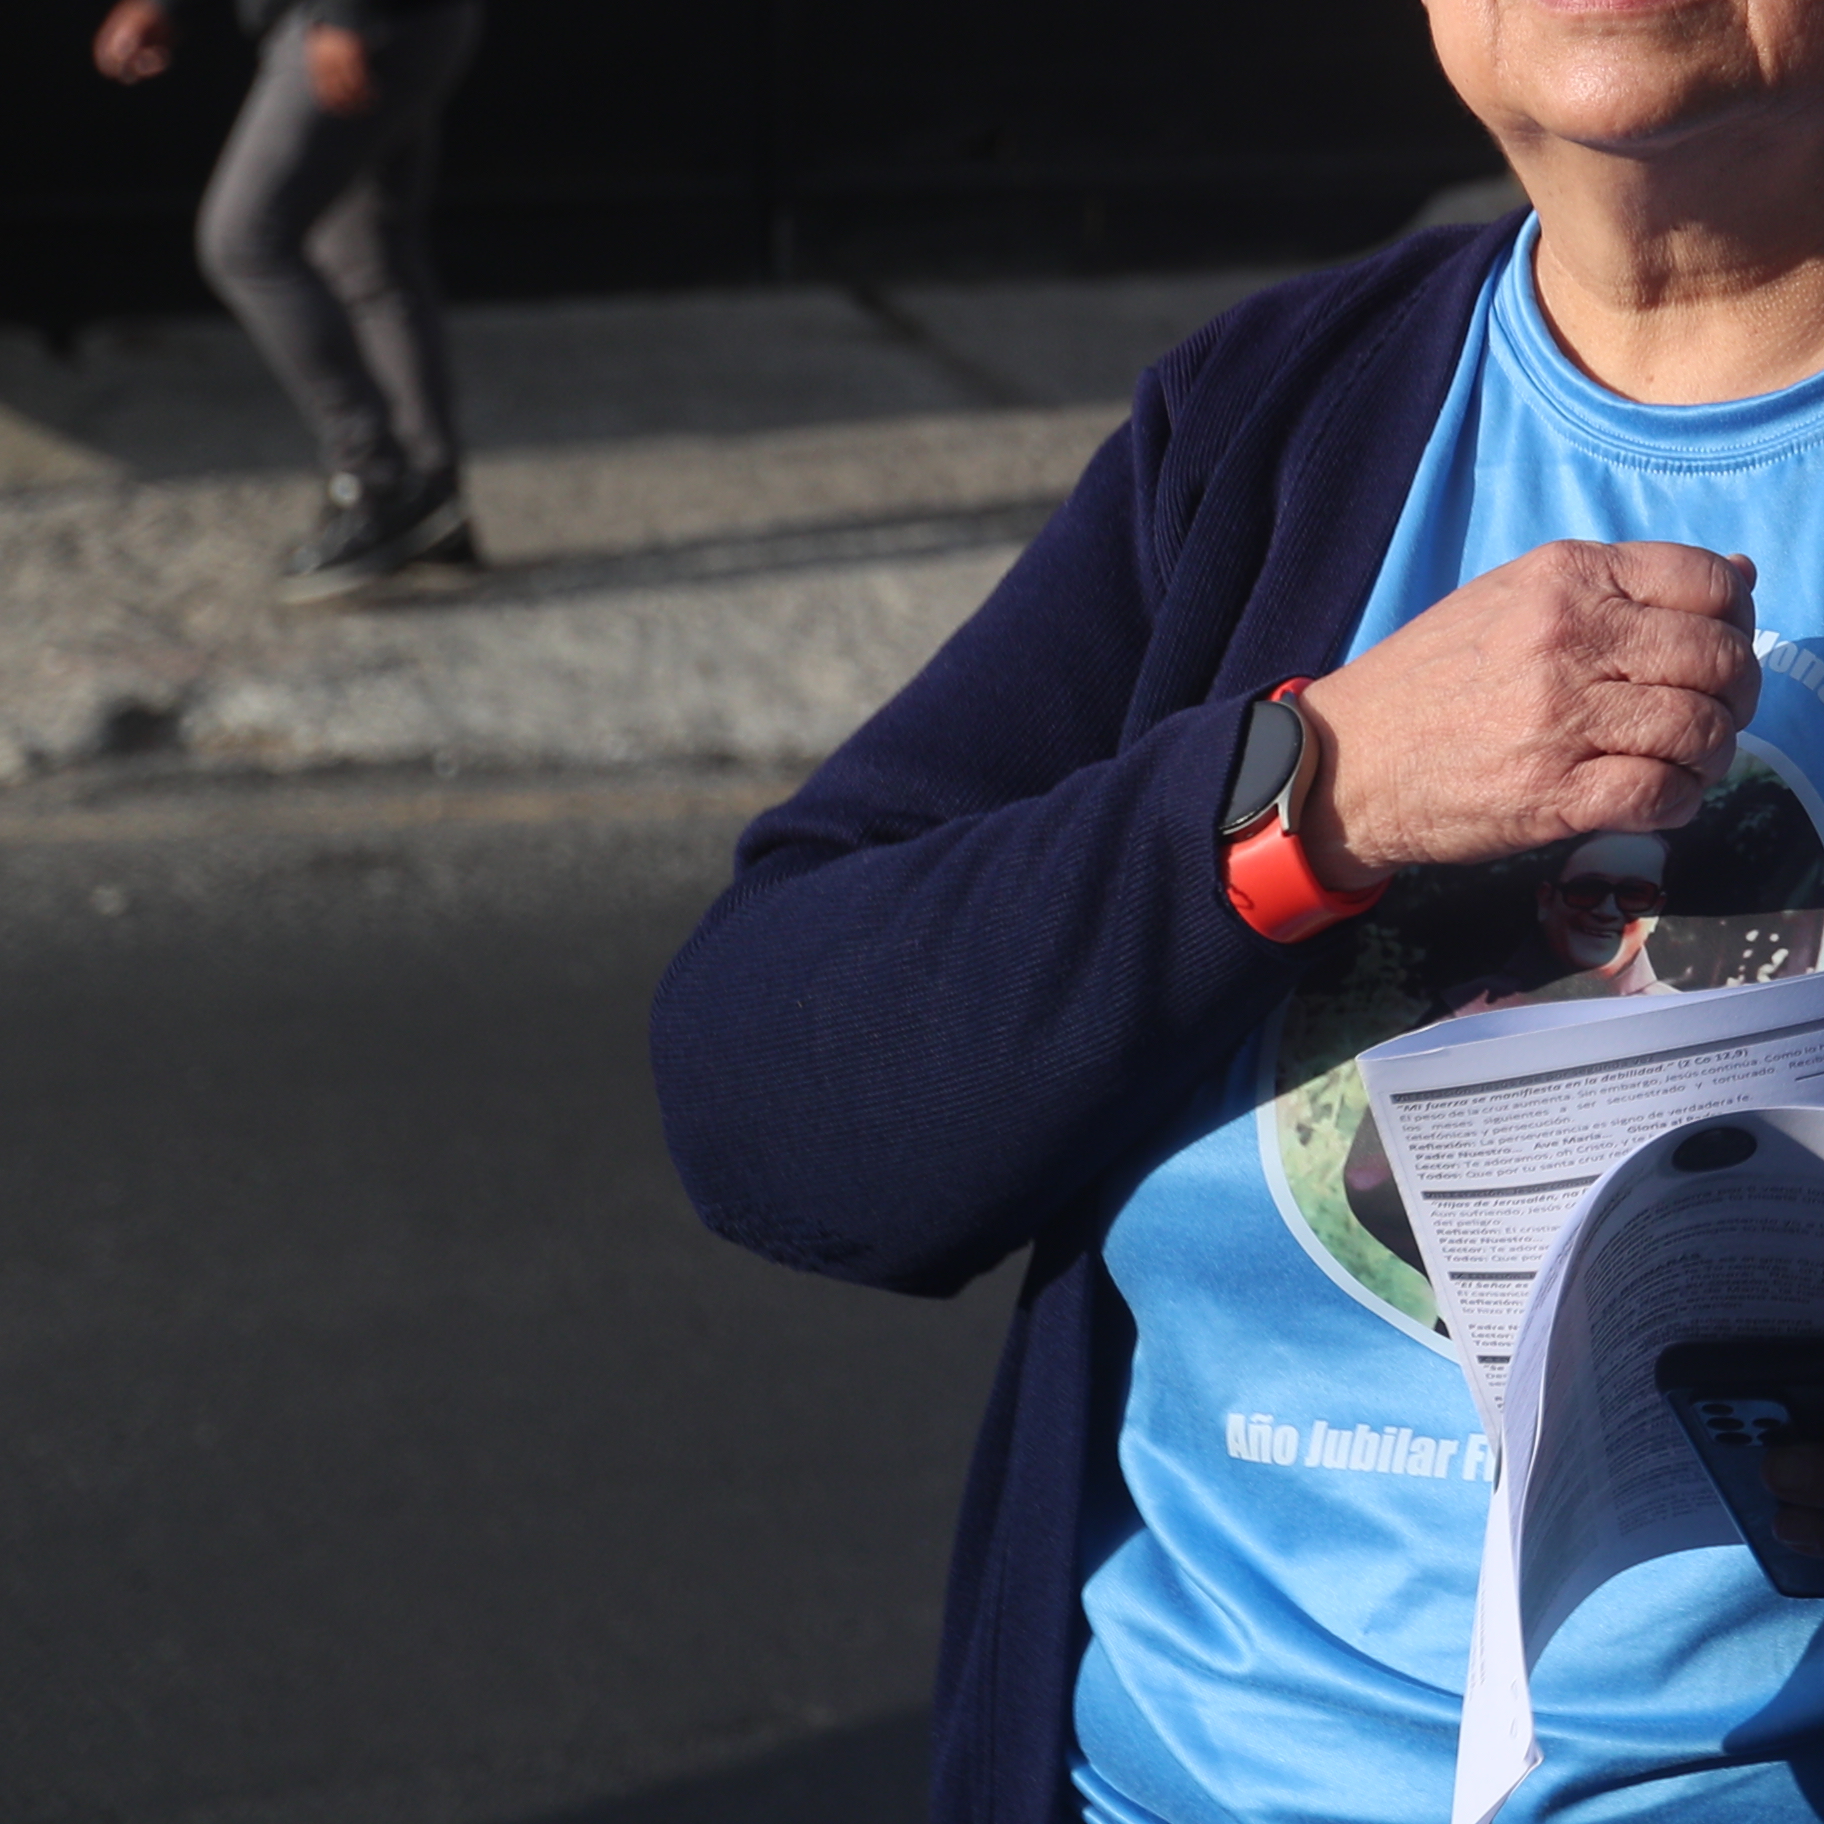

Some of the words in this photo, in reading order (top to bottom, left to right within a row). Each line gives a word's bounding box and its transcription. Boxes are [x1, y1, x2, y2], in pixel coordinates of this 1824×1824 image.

[1399, 1114, 1411, 1122] El
[1414, 1112, 1445, 1123] peso
[1448, 1109, 1465, 1117] de
[1467, 1108, 1480, 1116] la
[1482, 1105, 1509, 1114] cruz
[1577, 1088, 1597, 1098] Sin
[1599, 1077, 1662, 1094] embargo,
[1664, 1071, 1699, 1085] Jesús
[1764, 1049, 1801, 1064] Como
[1804, 1046, 1817, 1055] lo
[1425, 1098, 1468, 1111] fuerza
[1489, 1083, 1561, 1102] manifiesta
[1565, 1080, 1581, 1089] en
[1585, 1076, 1597, 1086] la
[1677, 1059, 1690, 1070] (2
[1694, 1056, 1711, 1066] Co
[1715, 1047, 1748, 1063] 12,9)
[1546, 1072, 1571, 1084] por
[1574, 1062, 1628, 1077] segunda
[1402, 1124, 1421, 1133] los
[1431, 1121, 1473, 1131] meses
[1483, 1109, 1550, 1125] siguientes
[1577, 1101, 1597, 1110] ser
[1606, 1085, 1686, 1106] secuestrado
[1695, 1081, 1703, 1090] y
[1405, 1130, 1477, 1141] telefónicas
[1482, 1129, 1490, 1138] y
[1492, 1117, 1575, 1136] persecución.
[1409, 1140, 1476, 1151] Reflexión:
[1479, 1138, 1494, 1146] La
[1498, 1125, 1589, 1145] perseverancia
[1610, 1115, 1645, 1127] signo
[1648, 1111, 1664, 1120] de
[1669, 1098, 1733, 1116] verdadera
[1415, 1152, 1454, 1161] Padre
[1533, 1139, 1560, 1150] Ave
[1627, 1121, 1668, 1133] Gloria
[1671, 1117, 1683, 1126] al
[1415, 1162, 1459, 1171] Lector:
[1465, 1160, 1478, 1168] Te
[1484, 1153, 1553, 1167] adoramos,
[1556, 1149, 1573, 1158] oh
[1576, 1141, 1618, 1154] Cristo,
[1622, 1138, 1630, 1147] y
[1632, 1135, 1645, 1144] te
[1417, 1171, 1461, 1180] Todos:
[1465, 1169, 1493, 1179] Que
[1497, 1166, 1519, 1177] por
[1522, 1165, 1537, 1173] tu
[1540, 1158, 1575, 1172] santa
[1578, 1155, 1605, 1165] cruz
[1459, 1207, 1525, 1218] sufriendo,
[1529, 1202, 1561, 1215] Jesús
[1473, 1199, 1490, 1207] de
[1493, 1192, 1558, 1208] Jerusalén,
[1561, 1190, 1579, 1199] no
[1433, 1218, 1451, 1226] del
[1436, 1226, 1500, 1236] Reflexión:
[1505, 1226, 1517, 1234] El
[1439, 1236, 1476, 1245] Padre
[1490, 1245, 1505, 1254] Te
[1491, 1254, 1516, 1263] Que
[1476, 1281, 1511, 1289] Señor
[1226, 1412, 1299, 1467] Año
[1304, 1419, 1460, 1479] Jubilar
